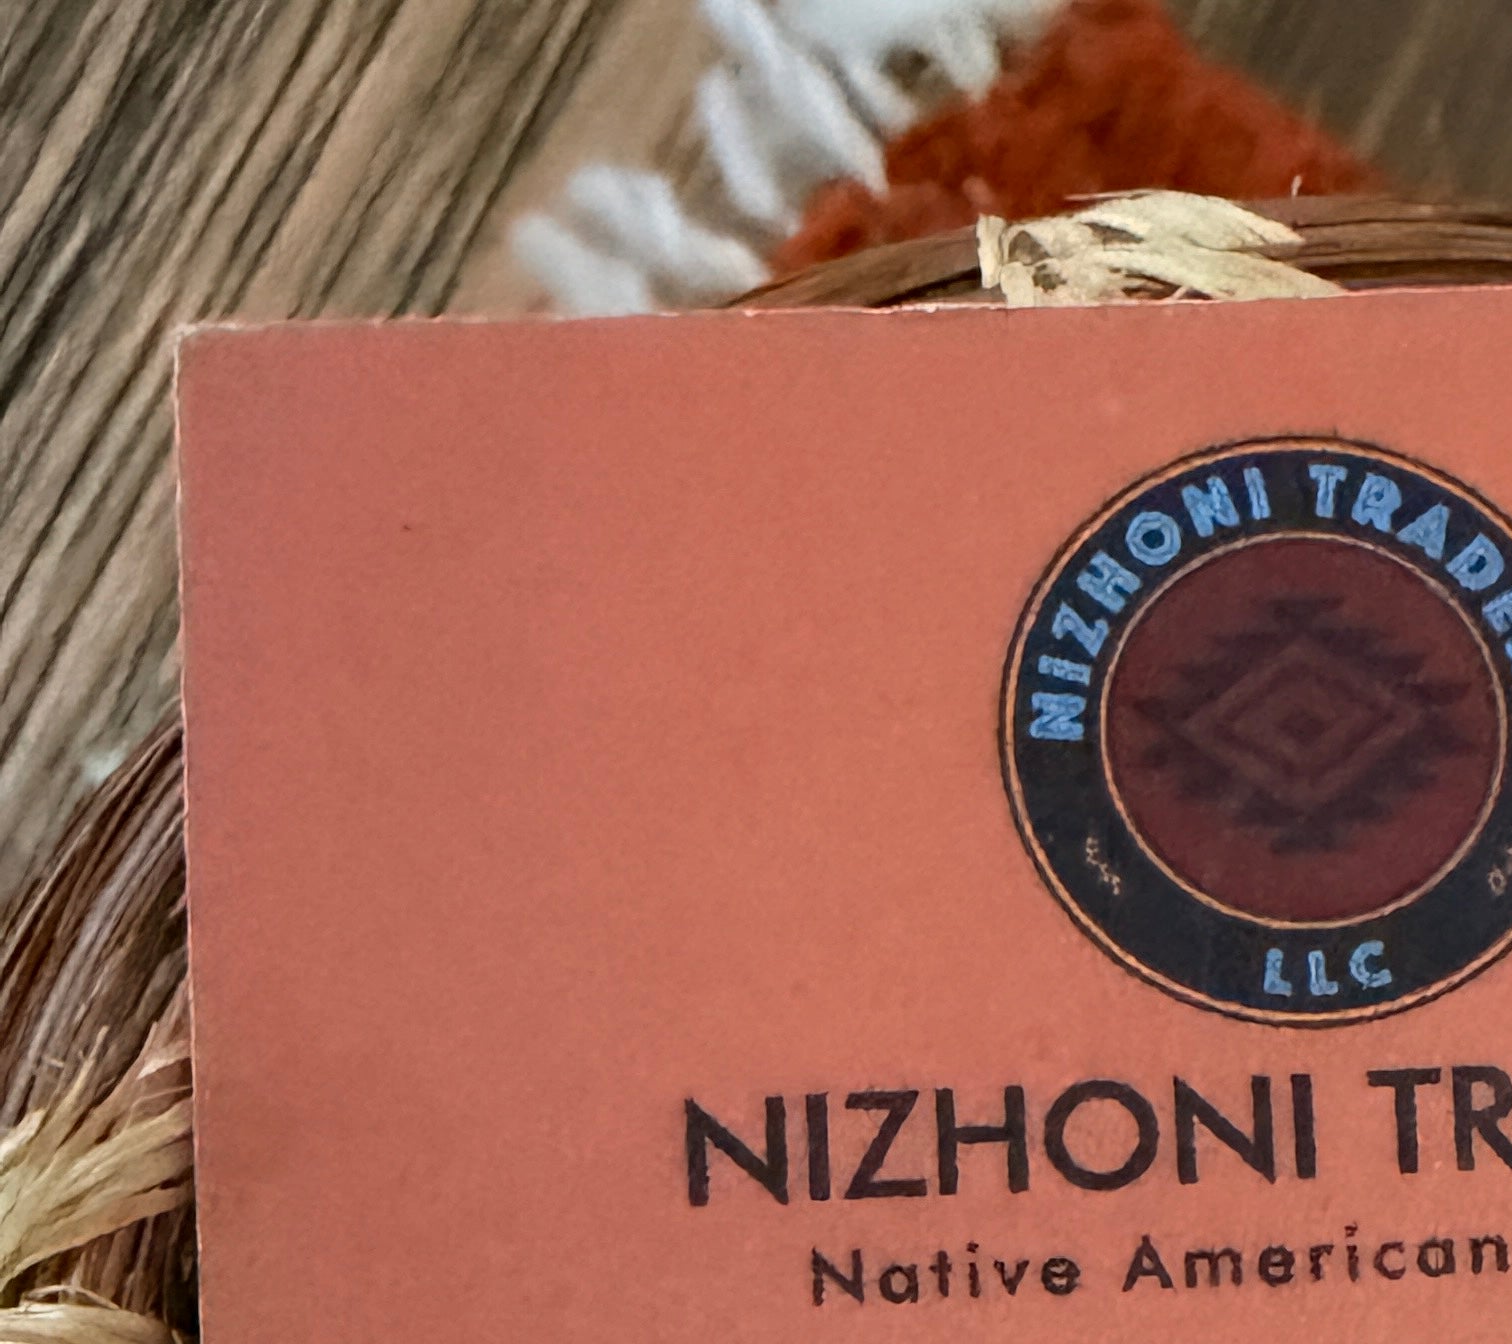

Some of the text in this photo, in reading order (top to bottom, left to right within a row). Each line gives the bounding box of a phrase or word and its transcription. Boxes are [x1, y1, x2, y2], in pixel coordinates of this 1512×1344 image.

[1029, 465, 1271, 742] NIZHONI
[1263, 940, 1392, 996] LLC
[684, 1073, 1317, 1206] NIZHONI
[811, 1241, 1082, 1306] Native
[1122, 1213, 1511, 1292] American
